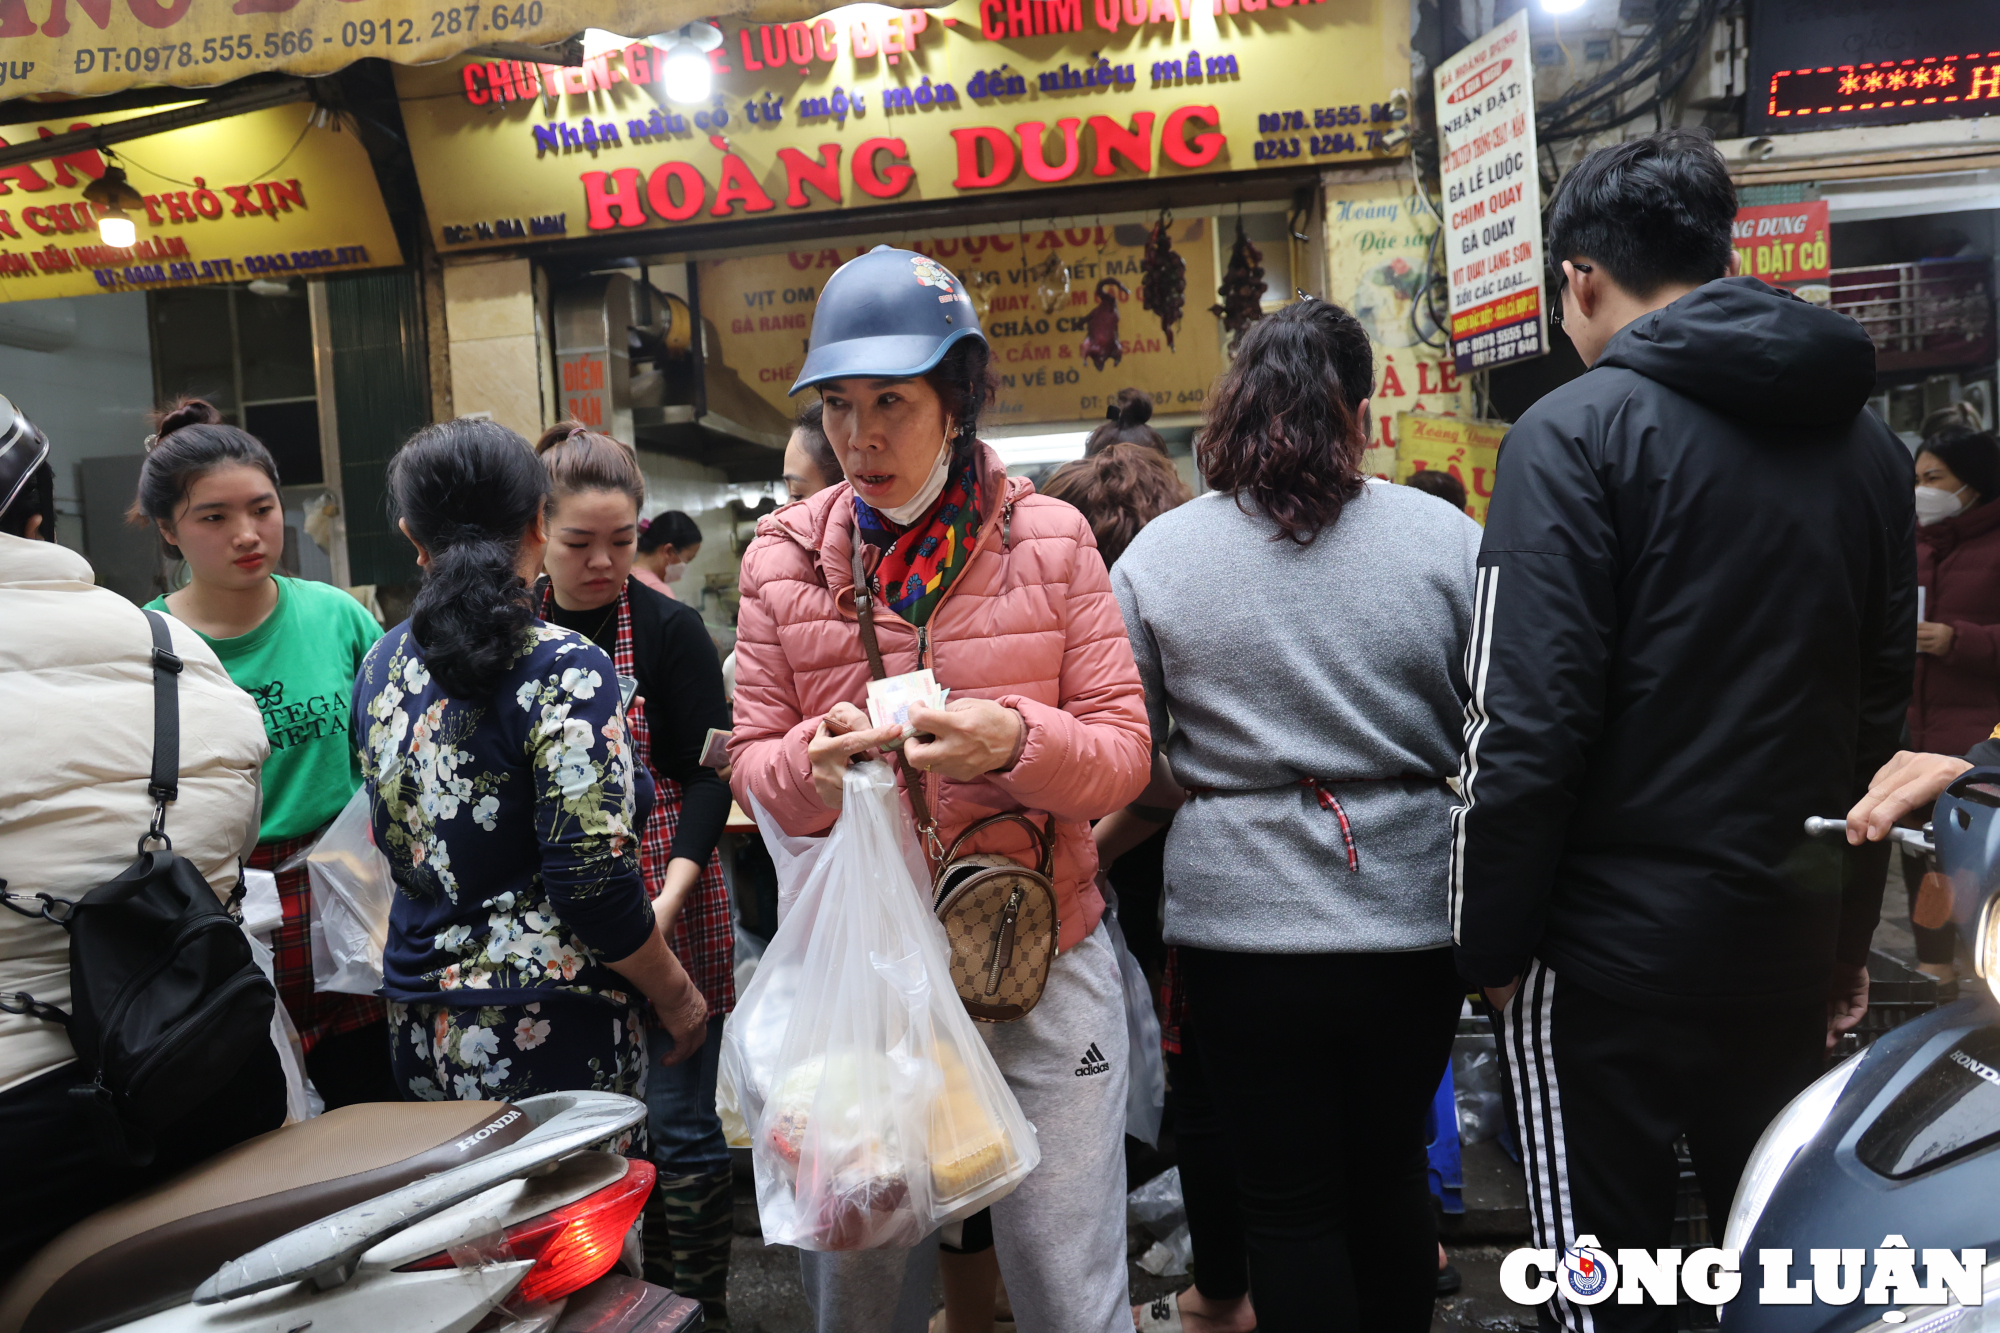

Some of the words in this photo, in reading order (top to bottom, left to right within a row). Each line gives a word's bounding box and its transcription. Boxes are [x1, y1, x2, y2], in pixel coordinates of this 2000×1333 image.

[74, 28, 313, 74] ĐT:0978.555.566
[342, 18, 421, 47] 0912.
[431, 1, 543, 38] 287.640
[980, 0, 1083, 41] CHIM
[533, 117, 620, 151] Nhận
[800, 86, 866, 121] một
[966, 64, 1027, 100] đến
[1037, 51, 1136, 92] nhiều
[1151, 50, 1239, 81] mâm
[1443, 104, 1482, 136] NHẬN
[1486, 82, 1522, 112] ĐẶT:
[581, 135, 915, 231] HOÀNG
[950, 105, 1226, 191] DUNG
[1450, 179, 1466, 203] GÀ
[1488, 152, 1523, 184] LUỘC
[143, 176, 222, 222] THỎ
[223, 179, 304, 220] XỊN
[1336, 199, 1398, 222] Hoàng
[1452, 200, 1485, 230] CHIM
[1489, 182, 1523, 214] QUAY
[1462, 230, 1478, 254] GÀ
[1483, 215, 1515, 246] QUAY
[1756, 214, 1808, 237] DUNG
[1466, 259, 1486, 282] QUAY
[1756, 238, 1796, 280] ĐẶT
[1799, 230, 1827, 271] CỖ
[743, 290, 775, 312] VỊT
[782, 287, 815, 304] OM
[732, 316, 754, 334] GÀ
[759, 313, 806, 331] RANG
[990, 315, 1049, 338] CHÁO
[1496, 325, 1522, 345] 5555
[1058, 343, 1072, 360] &
[1074, 1062, 1110, 1077] adidas
[455, 1110, 522, 1152] HONDA
